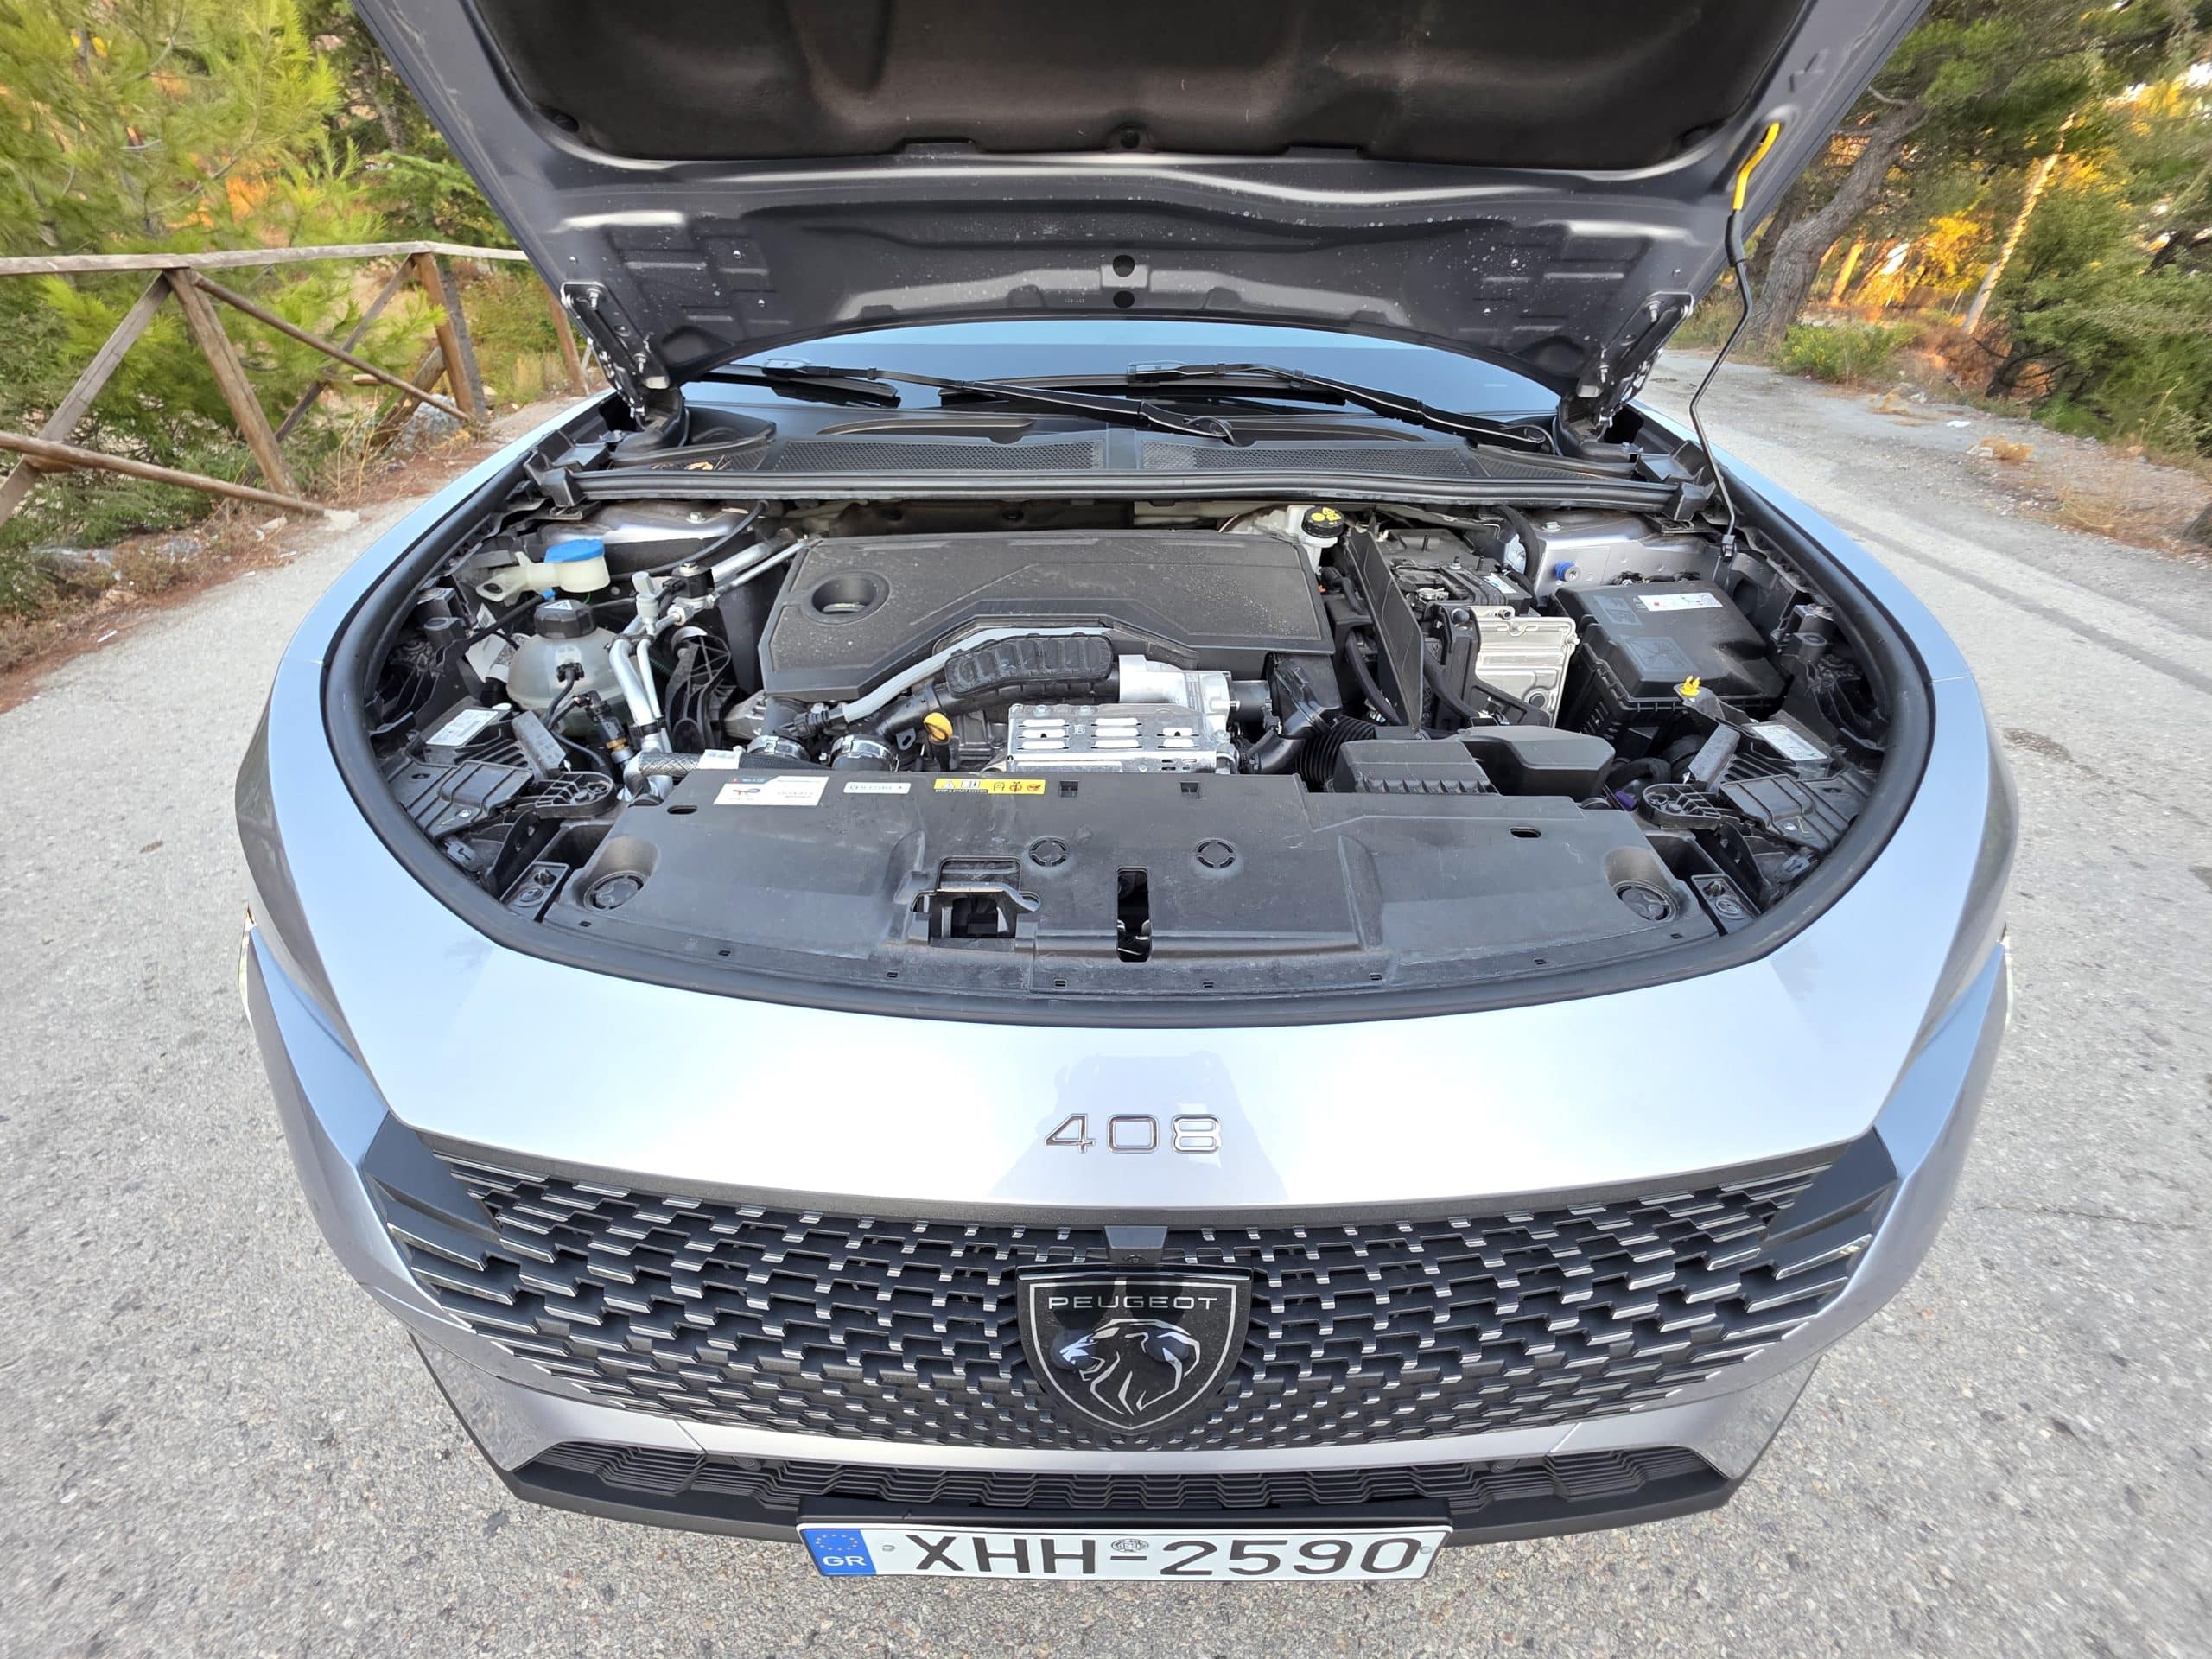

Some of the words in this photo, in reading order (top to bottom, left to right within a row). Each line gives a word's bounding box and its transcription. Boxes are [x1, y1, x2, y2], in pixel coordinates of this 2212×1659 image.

[1044, 1113, 1222, 1154] 408
[1048, 1295, 1218, 1310] PEUGEOT
[822, 1555, 867, 1567] GR
